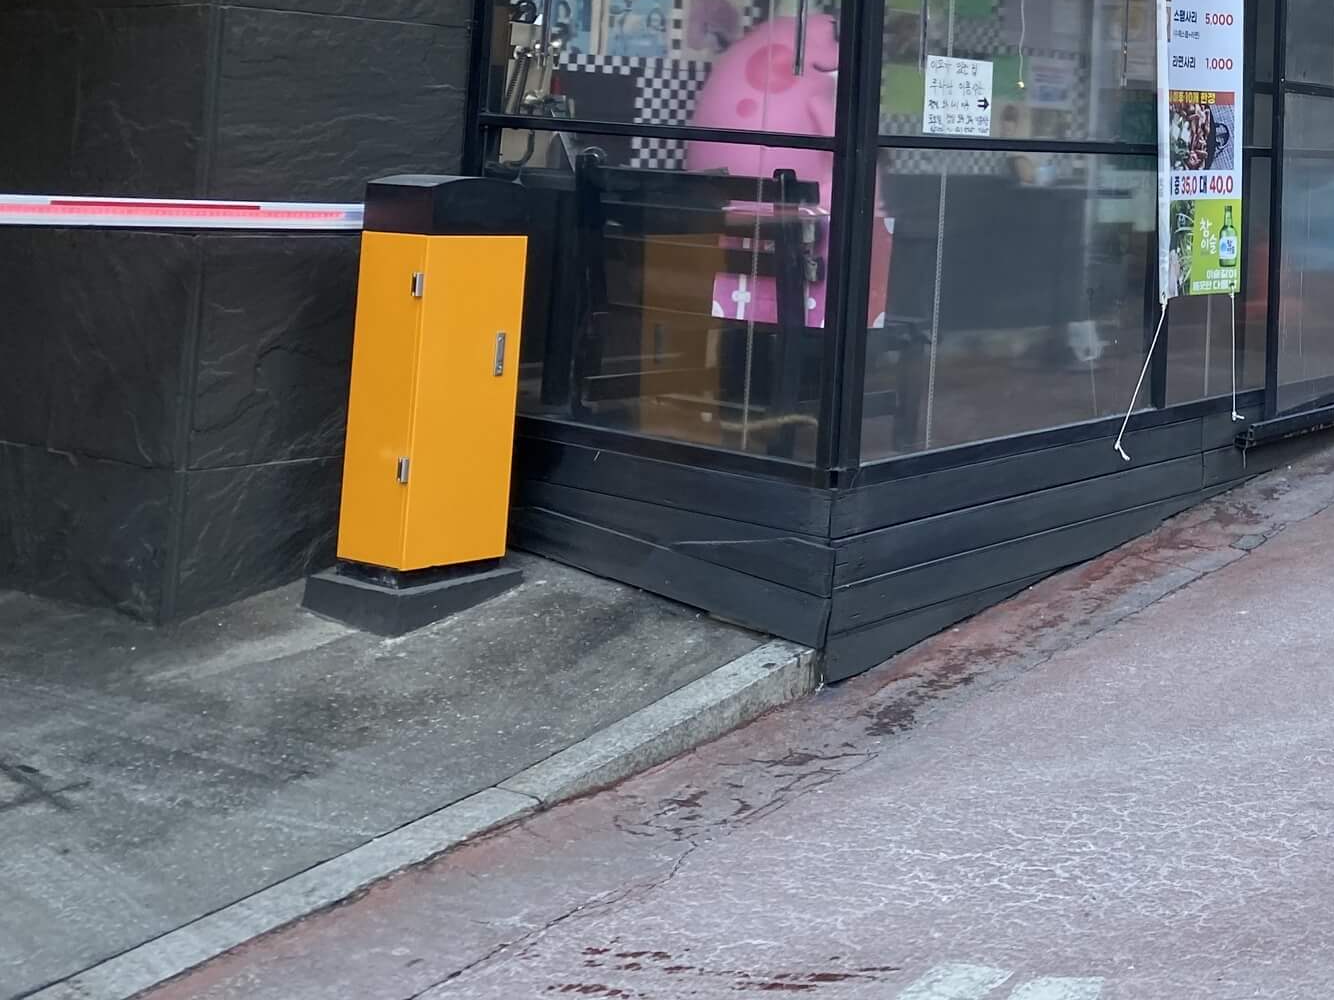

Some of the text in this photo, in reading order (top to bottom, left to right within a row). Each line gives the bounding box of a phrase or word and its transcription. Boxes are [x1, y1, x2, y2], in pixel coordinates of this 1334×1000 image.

[1205, 12, 1234, 26] 5,000
[1172, 55, 1233, 71] 라면사리 1,000
